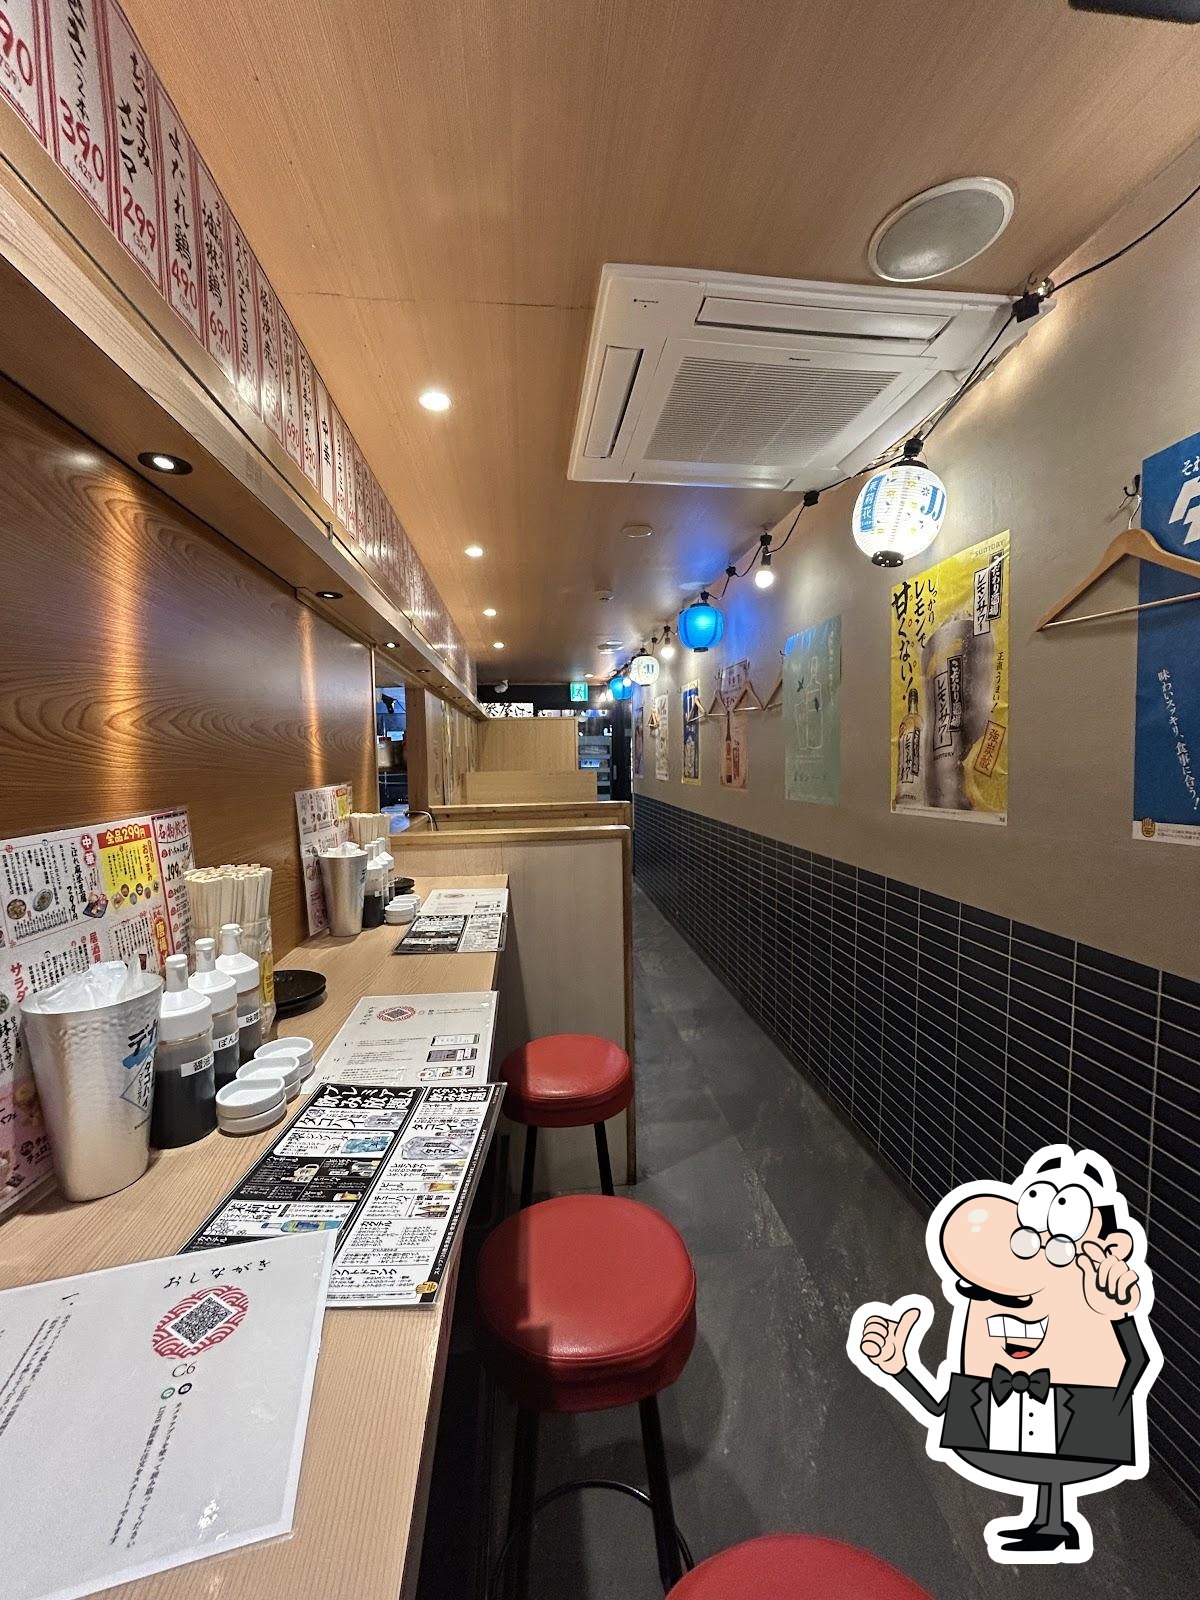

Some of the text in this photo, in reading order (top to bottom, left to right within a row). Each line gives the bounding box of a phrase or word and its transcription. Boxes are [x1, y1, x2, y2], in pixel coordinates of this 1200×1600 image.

[131, 51, 153, 175] おつまみ
[60, 96, 105, 182] 390
[119, 96, 136, 183] メンマ
[122, 186, 156, 252] 299
[167, 127, 193, 270] よだれ鶏
[171, 259, 198, 310] 490
[210, 310, 231, 356] 690
[914, 580, 927, 648] レモンで
[928, 578, 938, 625] しっかり
[937, 678, 950, 745] レモンサワー
[105, 824, 146, 846] 全品299円
[10, 962, 29, 1003] サラダ
[320, 1083, 418, 1099] プレミアム
[163, 1258, 272, 1289] おしながき
[172, 1362, 197, 1378] C6
